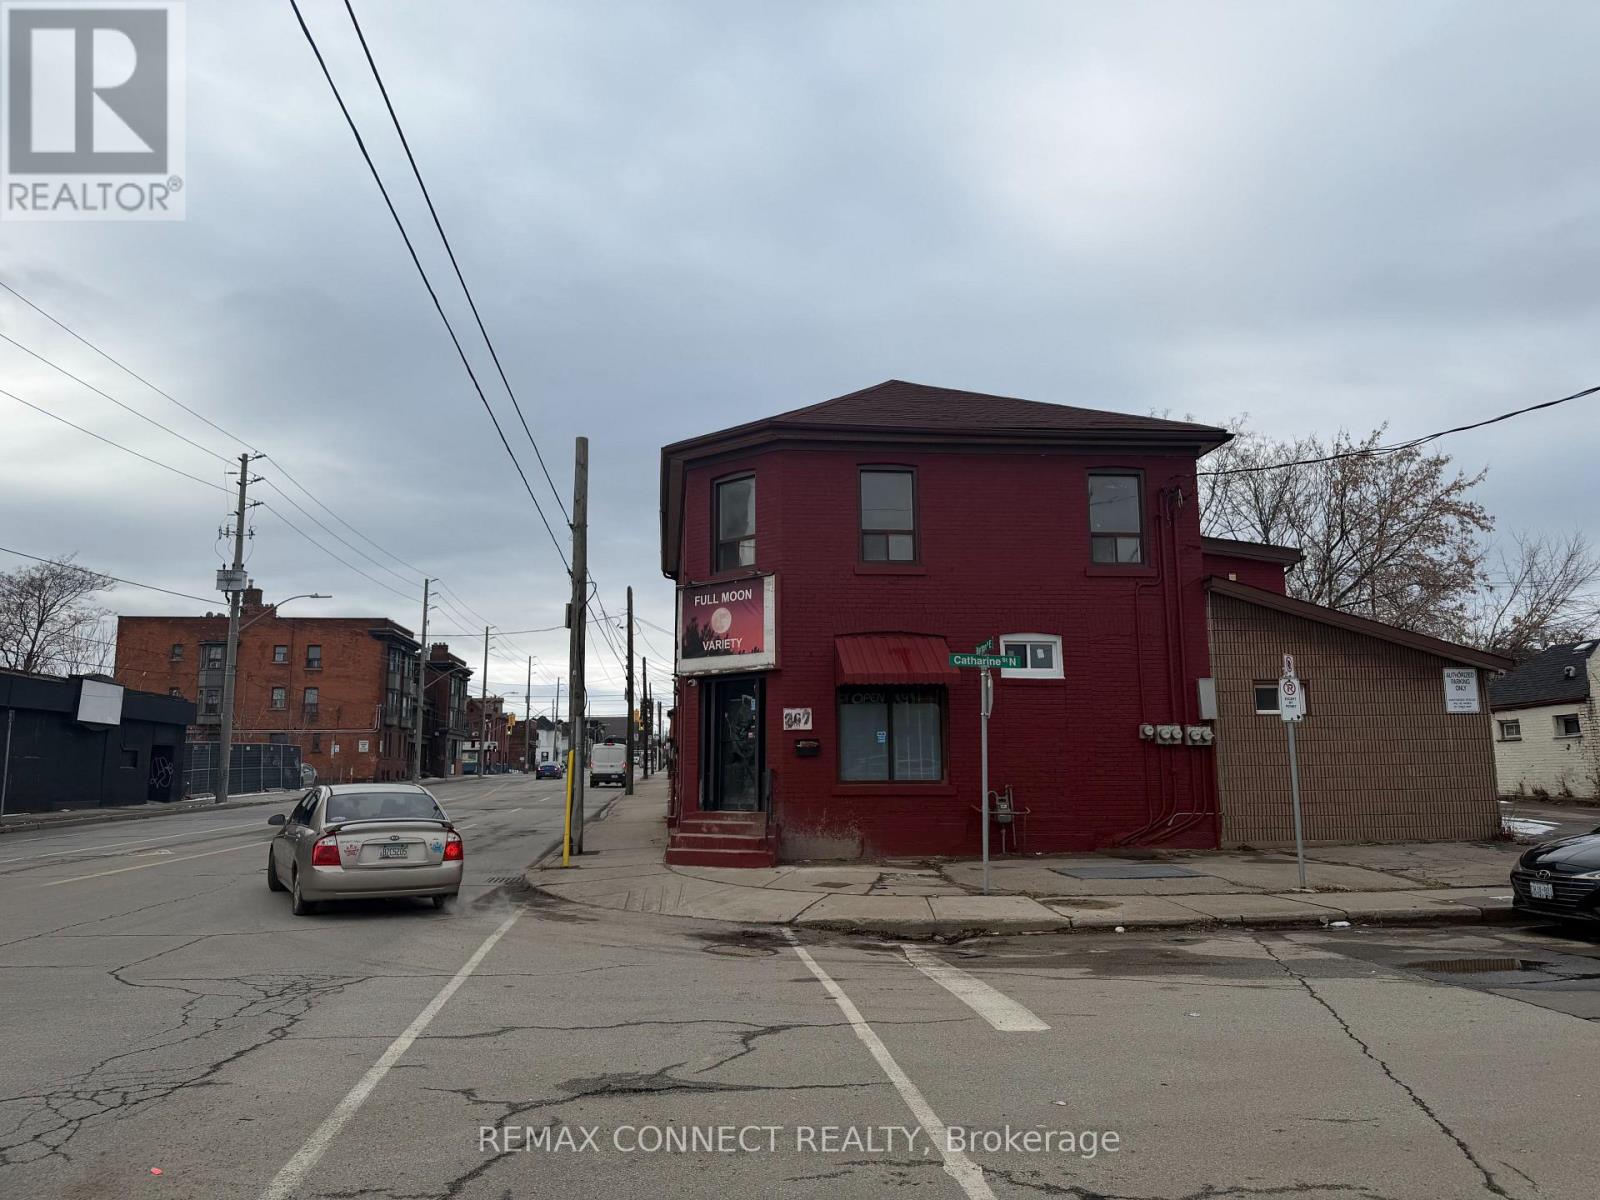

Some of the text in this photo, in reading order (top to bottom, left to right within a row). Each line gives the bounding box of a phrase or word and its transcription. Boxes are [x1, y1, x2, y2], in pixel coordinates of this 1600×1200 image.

[694, 589, 752, 606] FULL MOON
[702, 638, 743, 651] VARIETY
[953, 655, 1002, 666] Catharine
[1009, 657, 1017, 666] N
